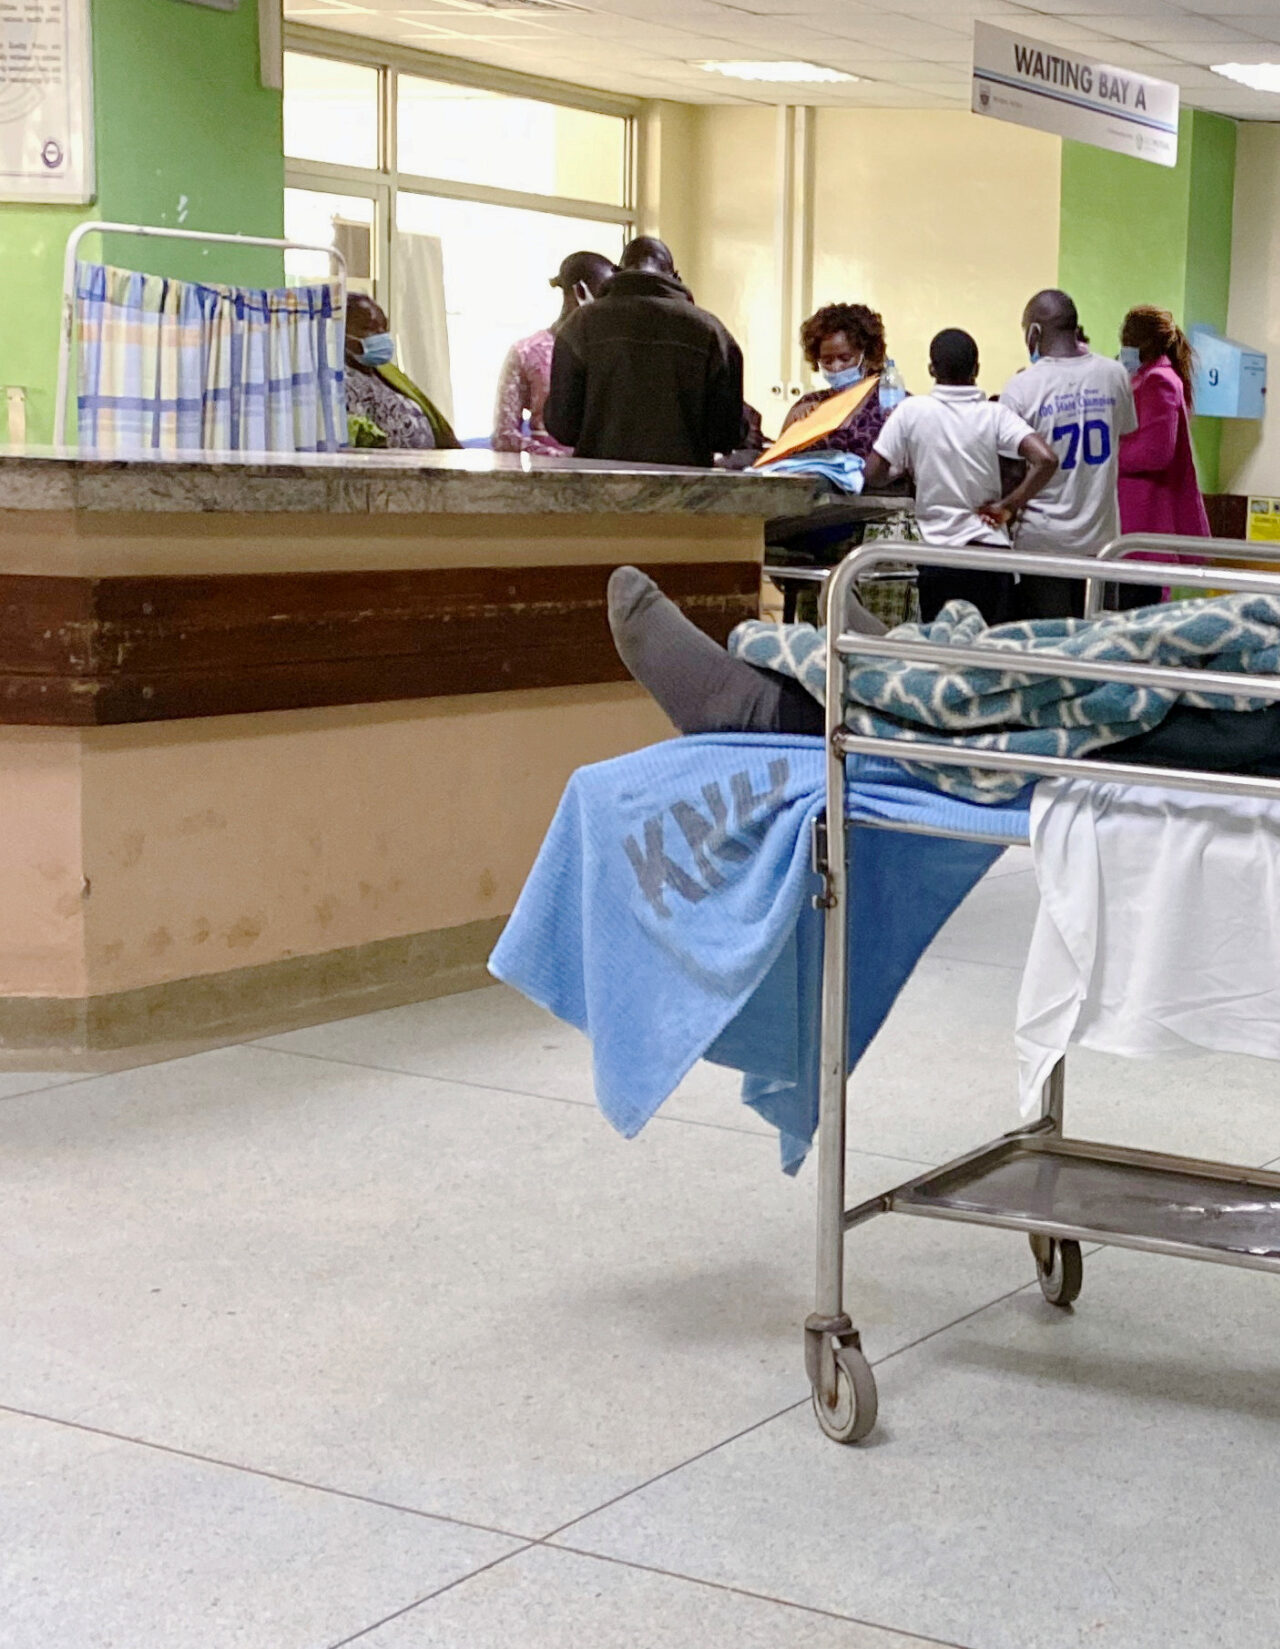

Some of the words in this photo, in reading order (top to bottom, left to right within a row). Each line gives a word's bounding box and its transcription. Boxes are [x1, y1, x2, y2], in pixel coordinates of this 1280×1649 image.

[1014, 43, 1093, 94] WAITING
[1098, 71, 1129, 104] BAY
[1134, 84, 1147, 111] A
[1208, 367, 1219, 387] 9
[1053, 419, 1111, 470] 70
[621, 757, 790, 919] KNH
